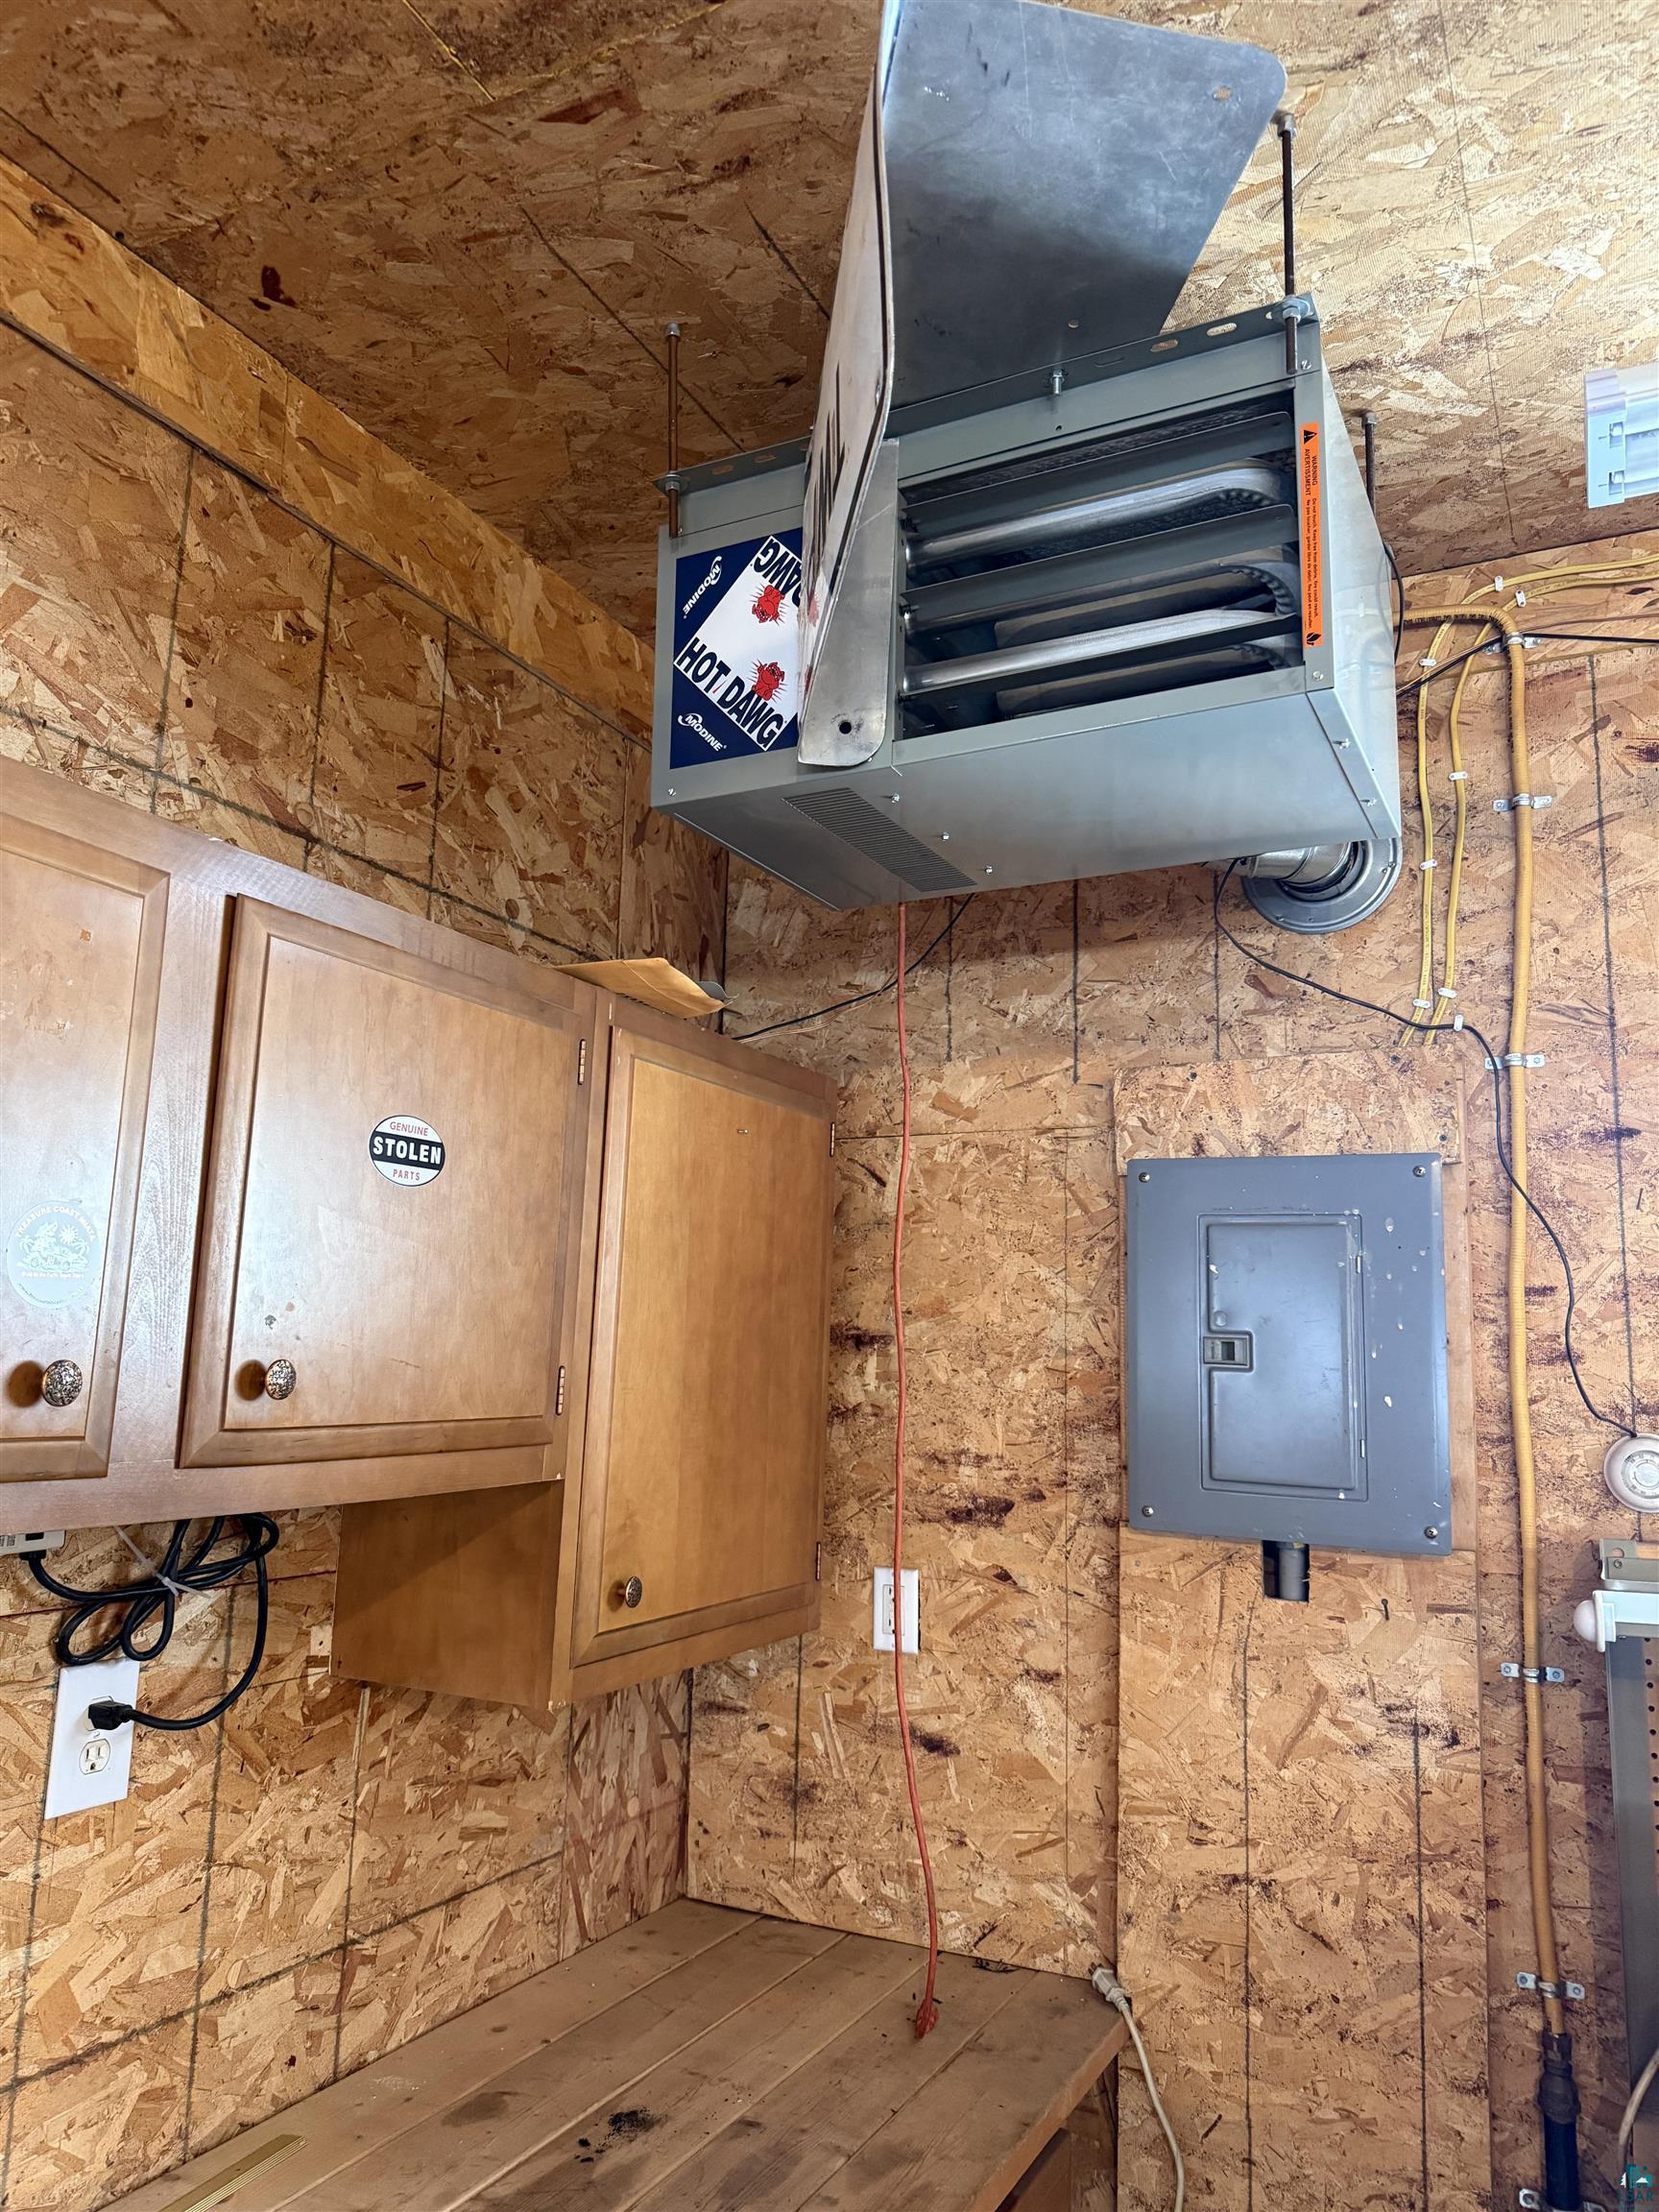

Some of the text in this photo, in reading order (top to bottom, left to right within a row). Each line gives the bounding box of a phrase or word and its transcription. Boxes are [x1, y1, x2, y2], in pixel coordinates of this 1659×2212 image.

[683, 563, 721, 614] MODINE
[675, 637, 784, 749] HOT DAWG
[684, 714, 723, 751] MODINE
[389, 1121, 429, 1137] GENUINE
[373, 1136, 442, 1165] STOLEN
[392, 1168, 421, 1181] PARTS
